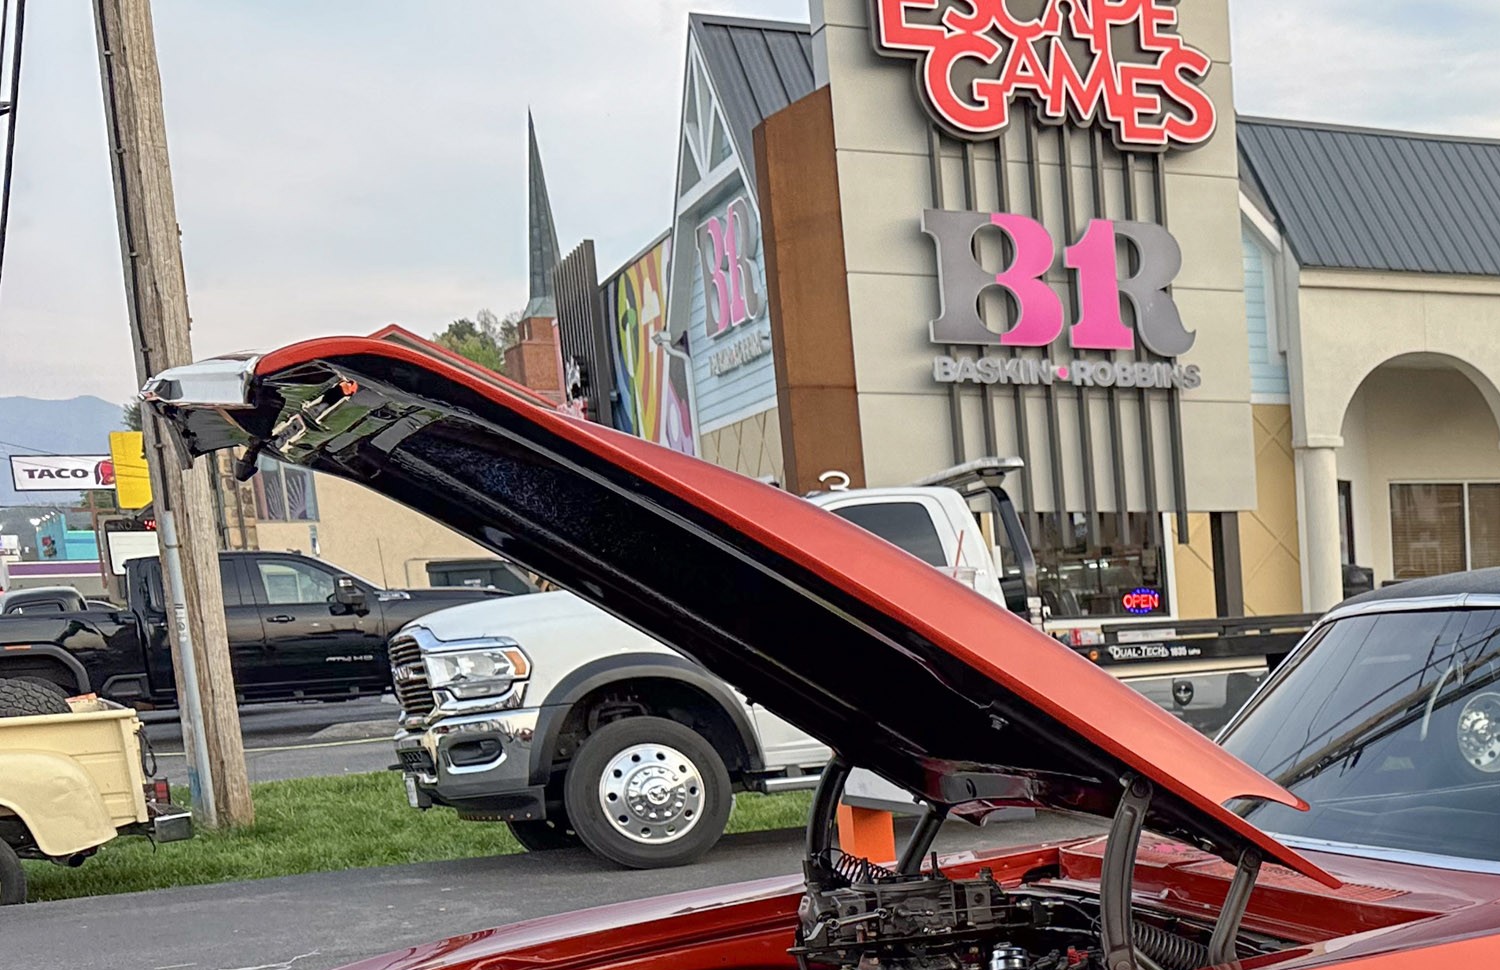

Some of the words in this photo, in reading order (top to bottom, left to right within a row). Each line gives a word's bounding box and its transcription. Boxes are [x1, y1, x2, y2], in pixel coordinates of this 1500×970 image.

[925, 30, 1217, 144] GAMES
[23, 468, 89, 479] TACO
[1123, 594, 1159, 608] OPEN
